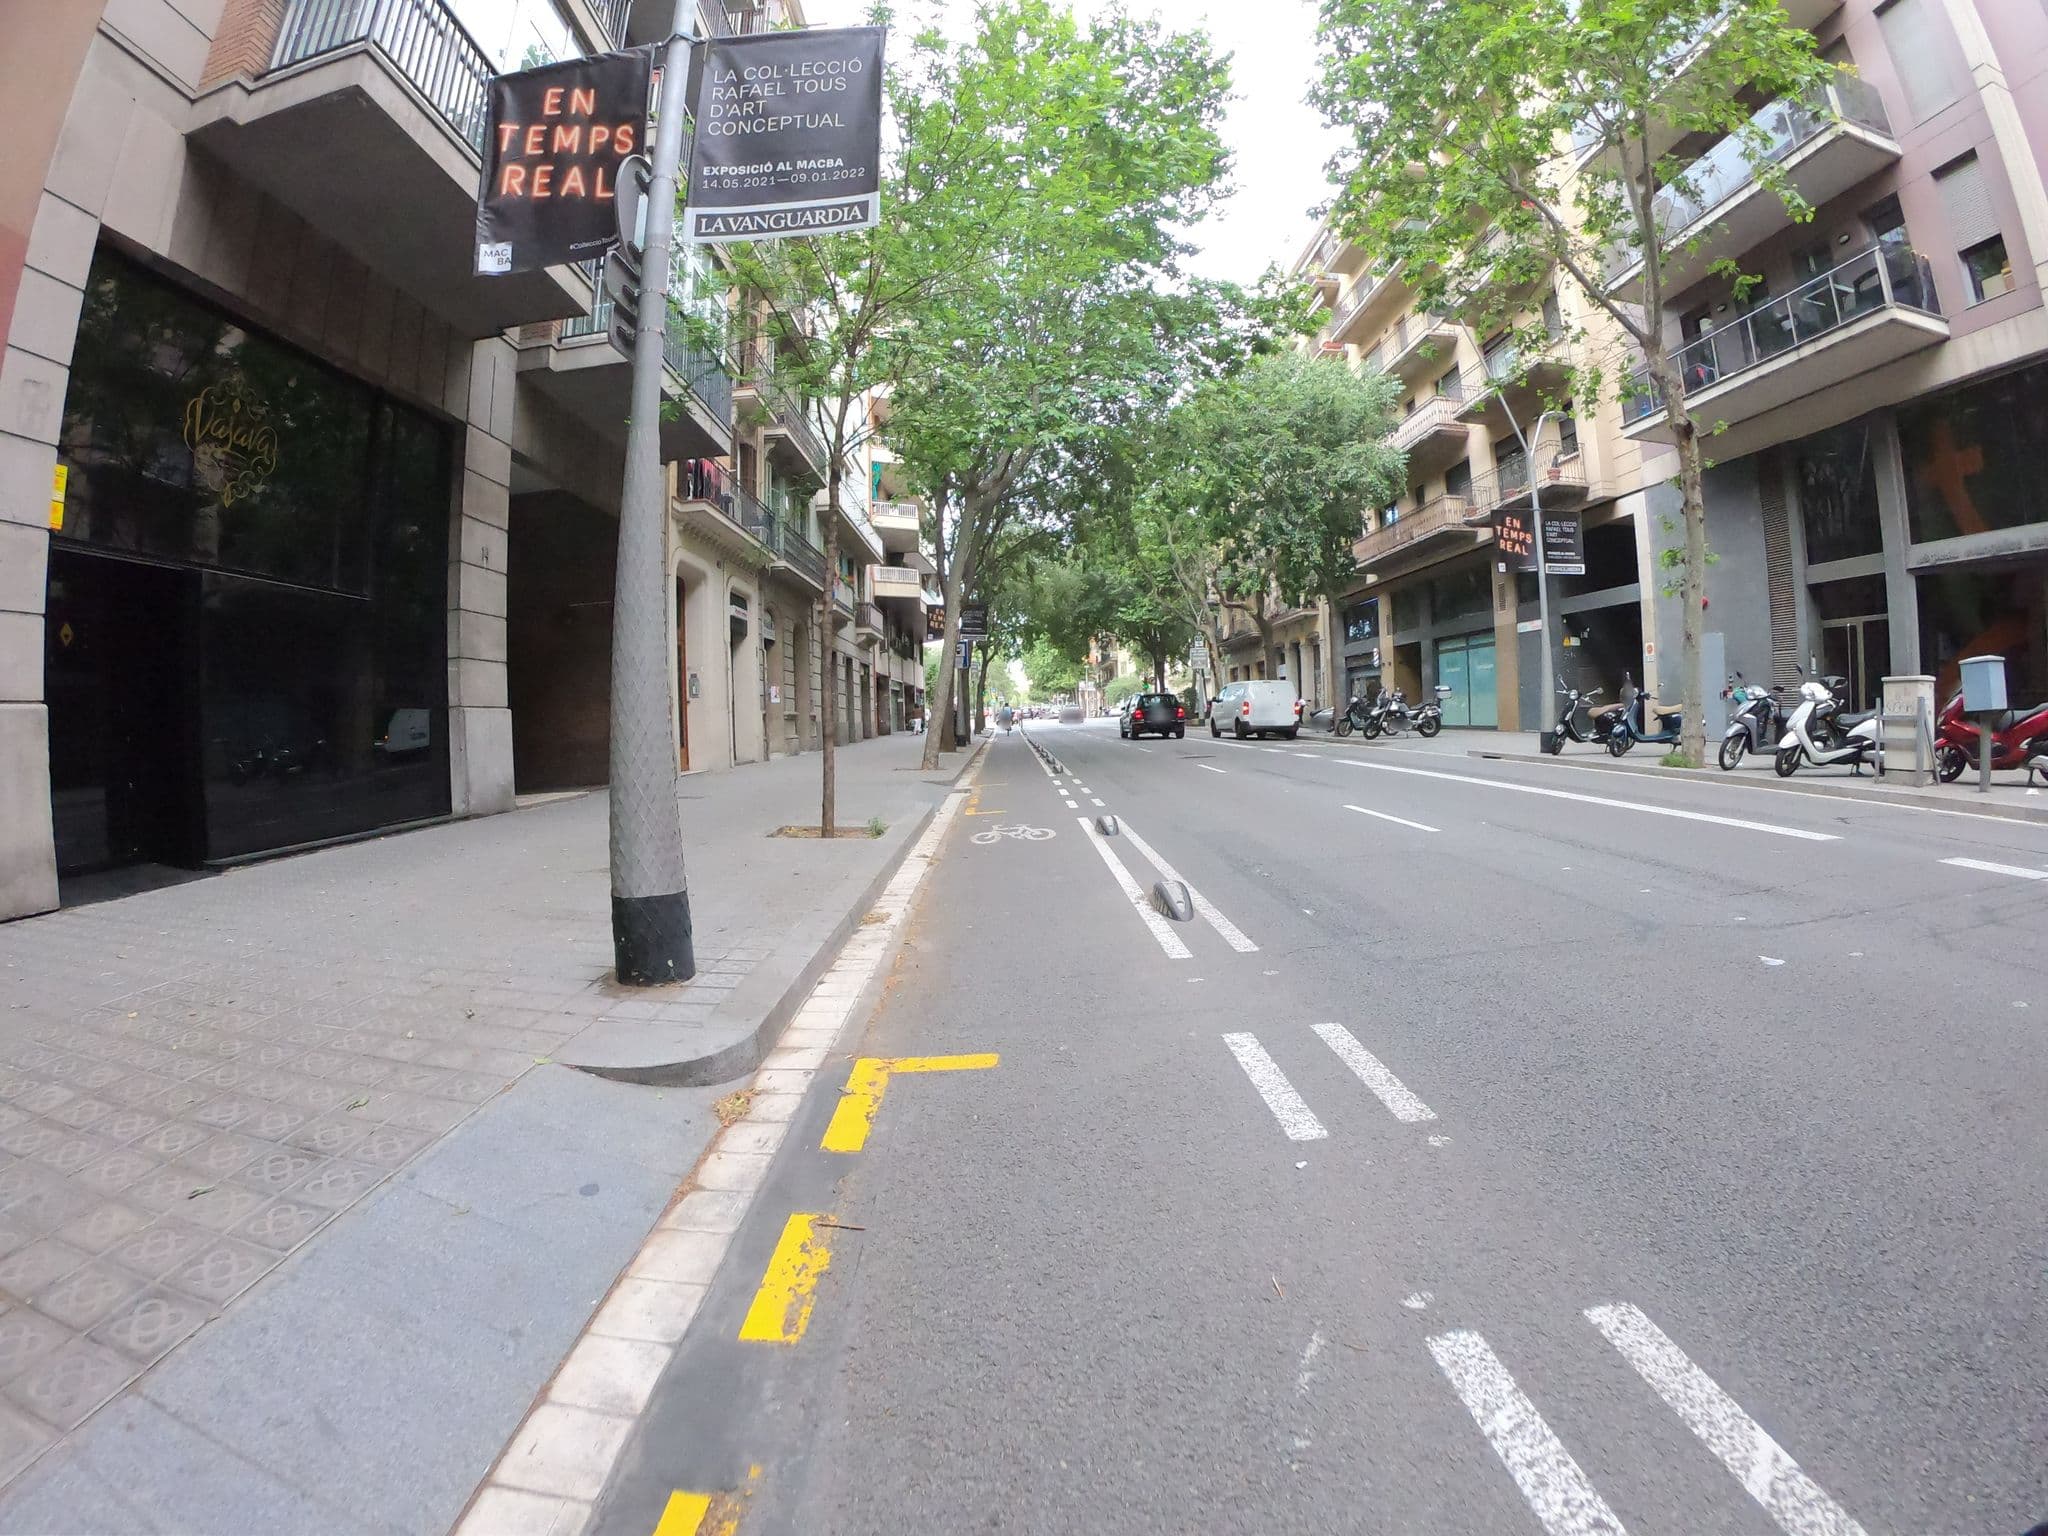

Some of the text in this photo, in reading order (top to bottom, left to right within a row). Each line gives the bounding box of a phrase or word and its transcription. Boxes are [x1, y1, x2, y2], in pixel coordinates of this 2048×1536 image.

[714, 69, 738, 84] LA
[712, 76, 847, 101] RAFAEL TOUS
[543, 88, 595, 116] EN
[710, 100, 767, 118] D'ART
[708, 112, 846, 136] CONCEPTUAL
[498, 124, 635, 155] TEMPS
[703, 157, 844, 176] EXPOSICIÓ AL MACBA
[501, 165, 615, 198] REAL
[483, 248, 508, 257] MAC
[497, 257, 512, 266] BA
[1505, 517, 1521, 529] EN
[1496, 525, 1532, 544] TEMPS
[1499, 539, 1528, 556] REAL
[928, 613, 945, 621] TEM
[929, 621, 945, 629] REA
